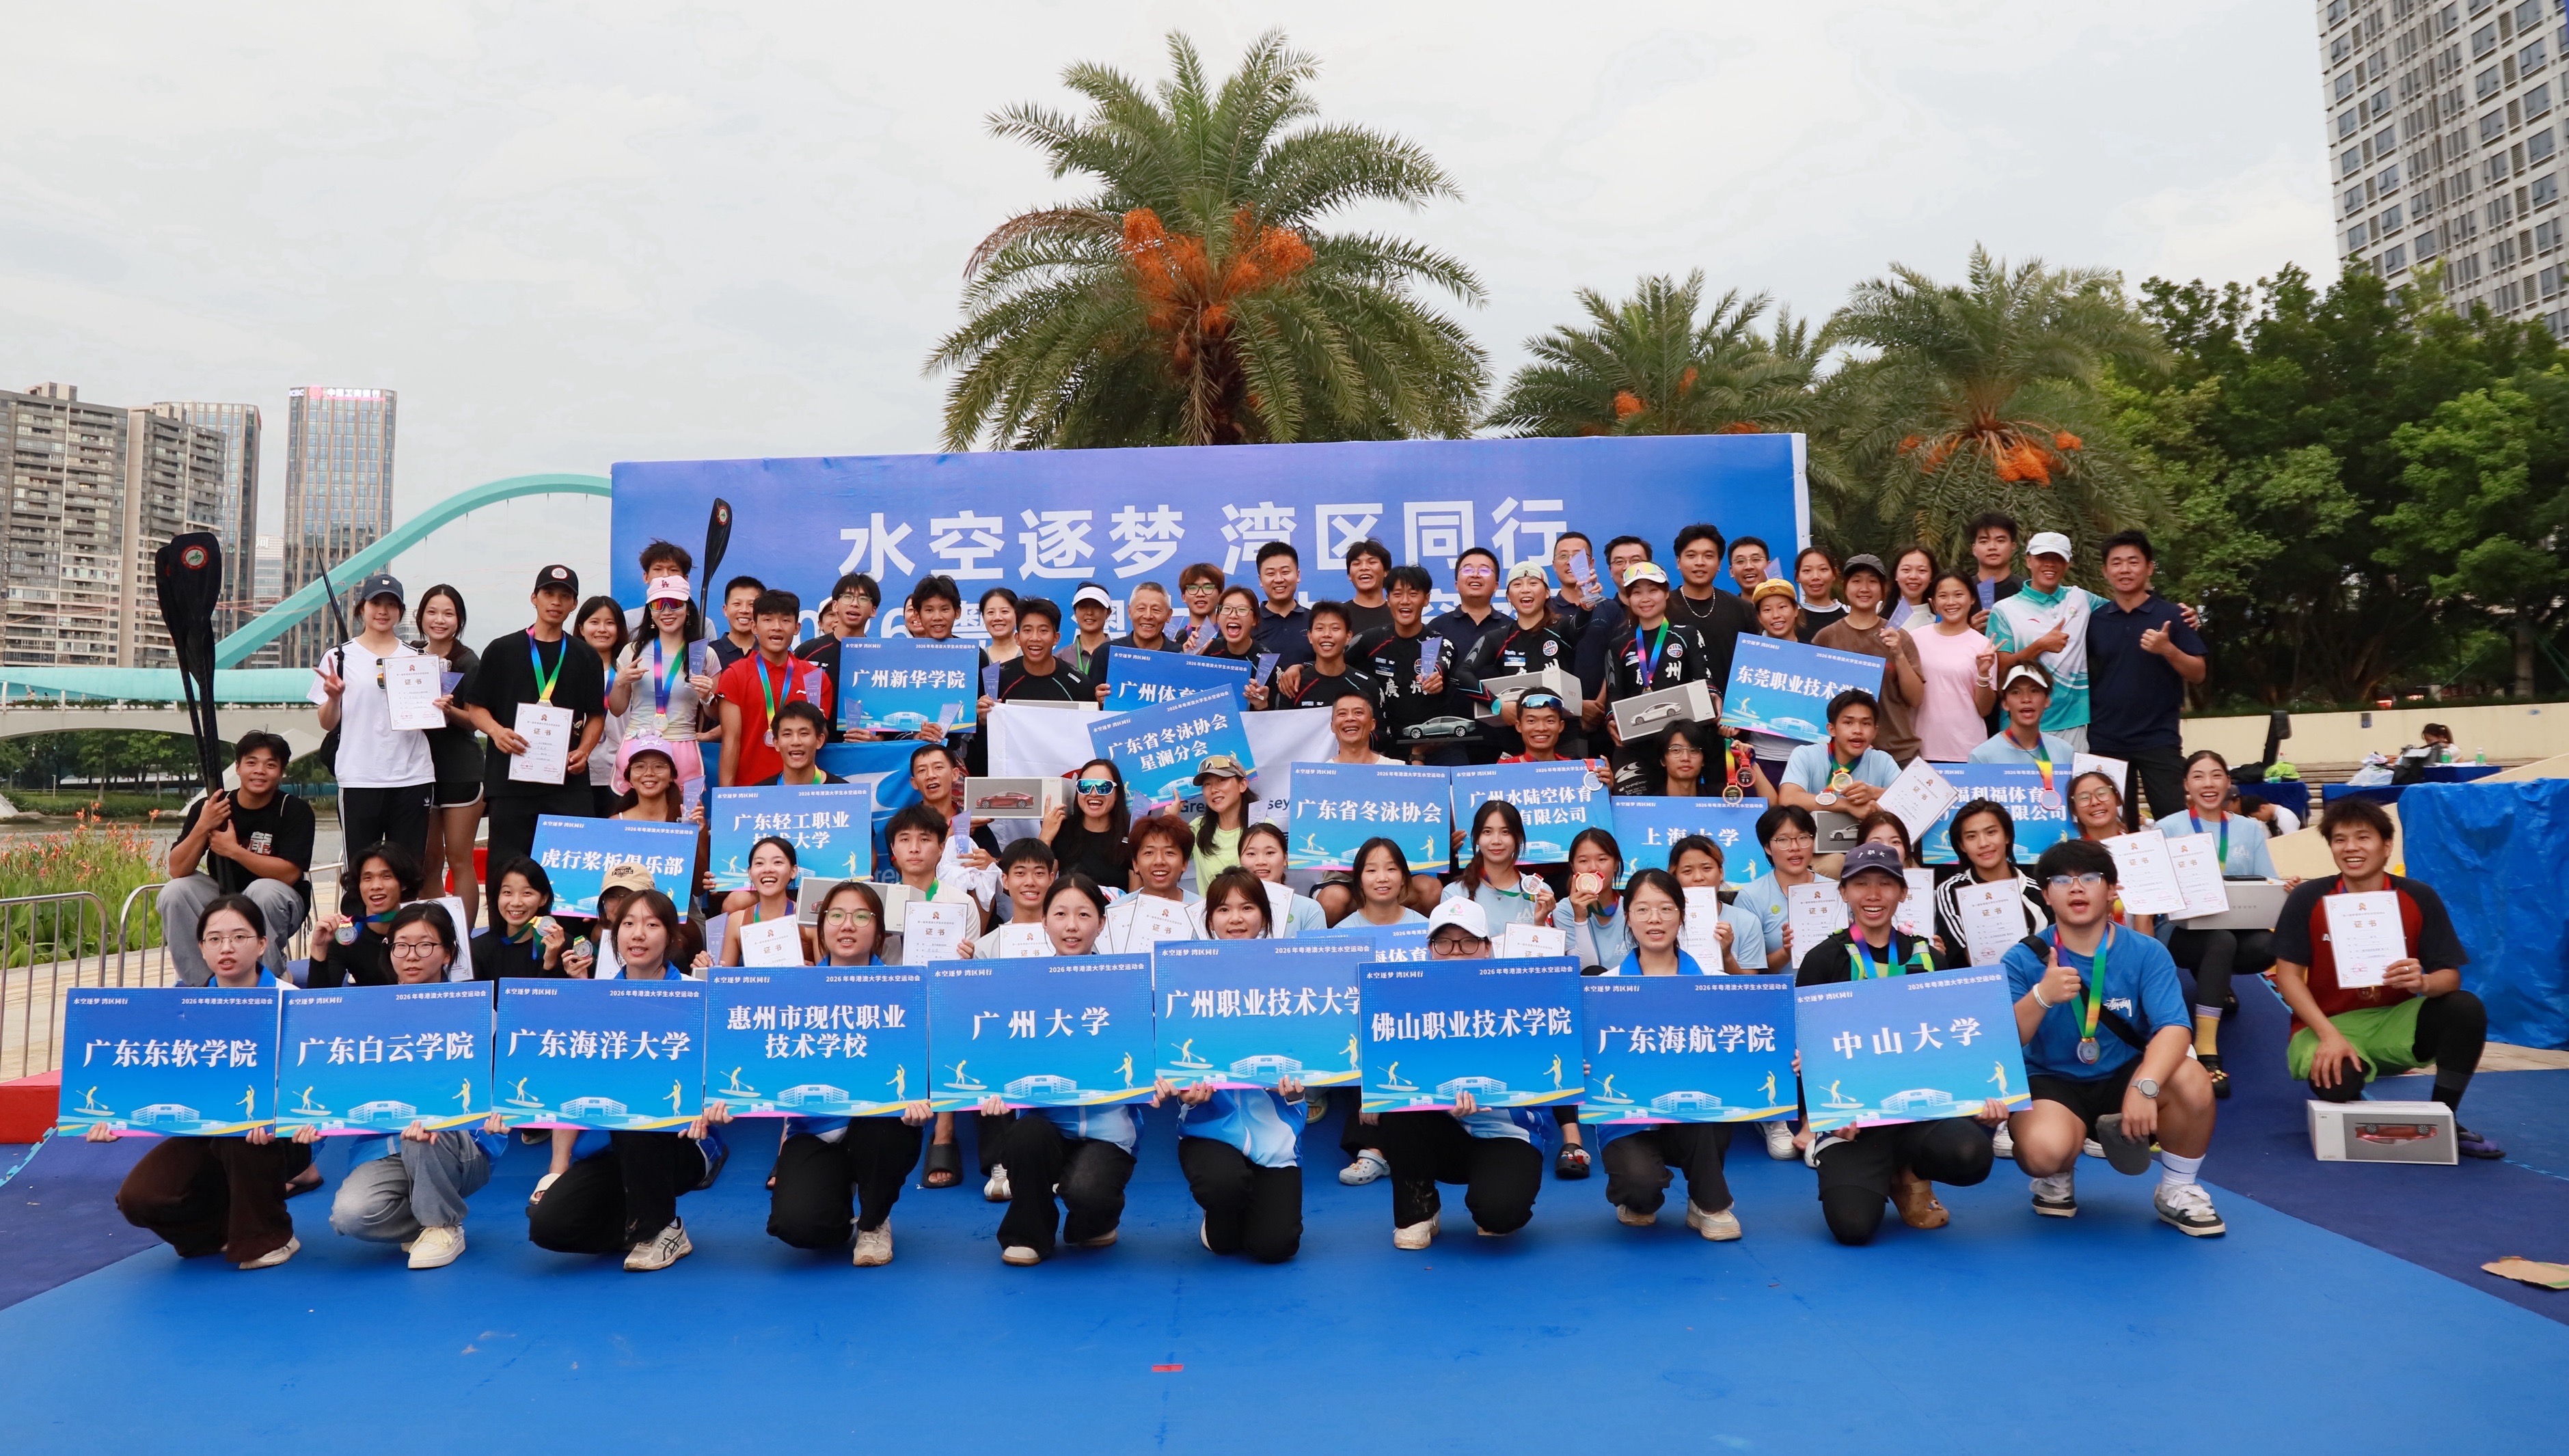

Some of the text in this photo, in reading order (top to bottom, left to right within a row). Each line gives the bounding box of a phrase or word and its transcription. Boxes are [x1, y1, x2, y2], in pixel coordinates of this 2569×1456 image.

[327, 388, 381, 398] 中国工商银行
[838, 496, 1568, 583] 水空逐梦 湾区同行
[853, 670, 965, 688] 广州新华学院
[1108, 713, 1228, 760] 广东省冬泳协会
[1141, 740, 1208, 771] 星澜分会
[1471, 786, 1592, 808] 广州水陆空体育
[734, 811, 849, 833] 广东轻工职业
[1297, 799, 1441, 823] 广东省冬泳协会
[1519, 806, 1586, 825] 有限公司
[1161, 948, 1190, 957] 水空逐梦
[1275, 945, 1370, 954] 2026年粤港澳大学生水空运动会
[742, 976, 770, 984] 湾区同行
[826, 974, 921, 983] 2026年粤港澳大学生水空运动会
[934, 970, 963, 978] 水空逐梦
[1048, 963, 1145, 973] 2026年粤港澳大学生水空运动会
[1366, 970, 1424, 979] 水空逐梦 湾区同行
[1479, 965, 1573, 976] 2026年粤港澳大学生水空运动会
[1166, 986, 1359, 1019] 广州职业技术大学
[727, 1004, 905, 1030] 惠州市现代职业
[973, 1007, 1109, 1040] 广州大学
[1372, 1007, 1572, 1041] 佛山职业技术学院
[297, 1032, 474, 1066] 广东白云学院
[508, 1029, 690, 1060] 广东海洋大学
[765, 1033, 867, 1058] 技术学校
[1599, 1024, 1776, 1054] 广东海航学院
[1833, 1017, 1981, 1059] 中山大学
[83, 1039, 257, 1067] 广东东软学院
